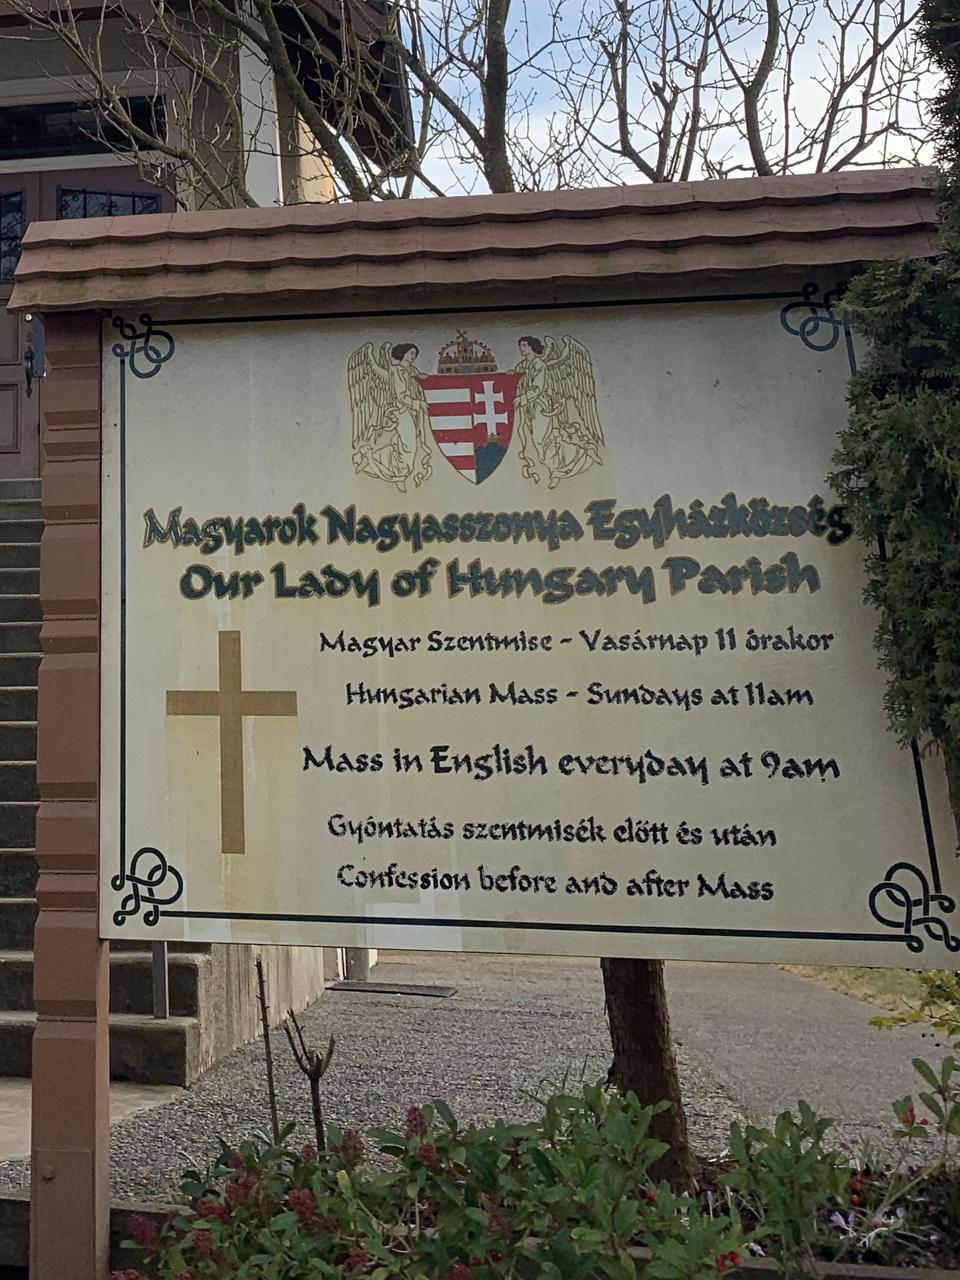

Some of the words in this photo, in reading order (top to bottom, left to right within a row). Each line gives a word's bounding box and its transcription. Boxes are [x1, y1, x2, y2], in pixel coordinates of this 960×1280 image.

[143, 502, 319, 556] Magyarok
[320, 504, 585, 553] Nagyasszonya
[180, 564, 264, 600] Our
[270, 561, 381, 607] Lady
[391, 556, 441, 598] of
[446, 557, 657, 605] Hungary
[661, 551, 821, 596] Parish
[320, 630, 421, 657] Magyar
[427, 630, 553, 651] Szentmise
[578, 628, 709, 656] Vasárnap
[714, 627, 737, 651] 11
[345, 681, 481, 709] Hungarian
[489, 681, 558, 705] Mass
[587, 682, 703, 711] Sundays
[710, 685, 739, 705] at
[744, 682, 814, 705] 11am
[303, 745, 384, 772] Mass
[393, 748, 423, 772] in
[429, 743, 547, 780] English
[558, 749, 709, 785] everyday
[720, 752, 753, 778] at
[760, 750, 840, 780] 9am
[327, 814, 455, 844] Gyóntatás
[463, 816, 607, 842] szentmisék
[676, 821, 703, 845] és
[711, 823, 777, 846] után
[337, 863, 471, 890] Confession
[477, 865, 558, 894] before
[565, 872, 618, 896] and
[626, 869, 690, 897] after
[697, 872, 775, 901] Mass
